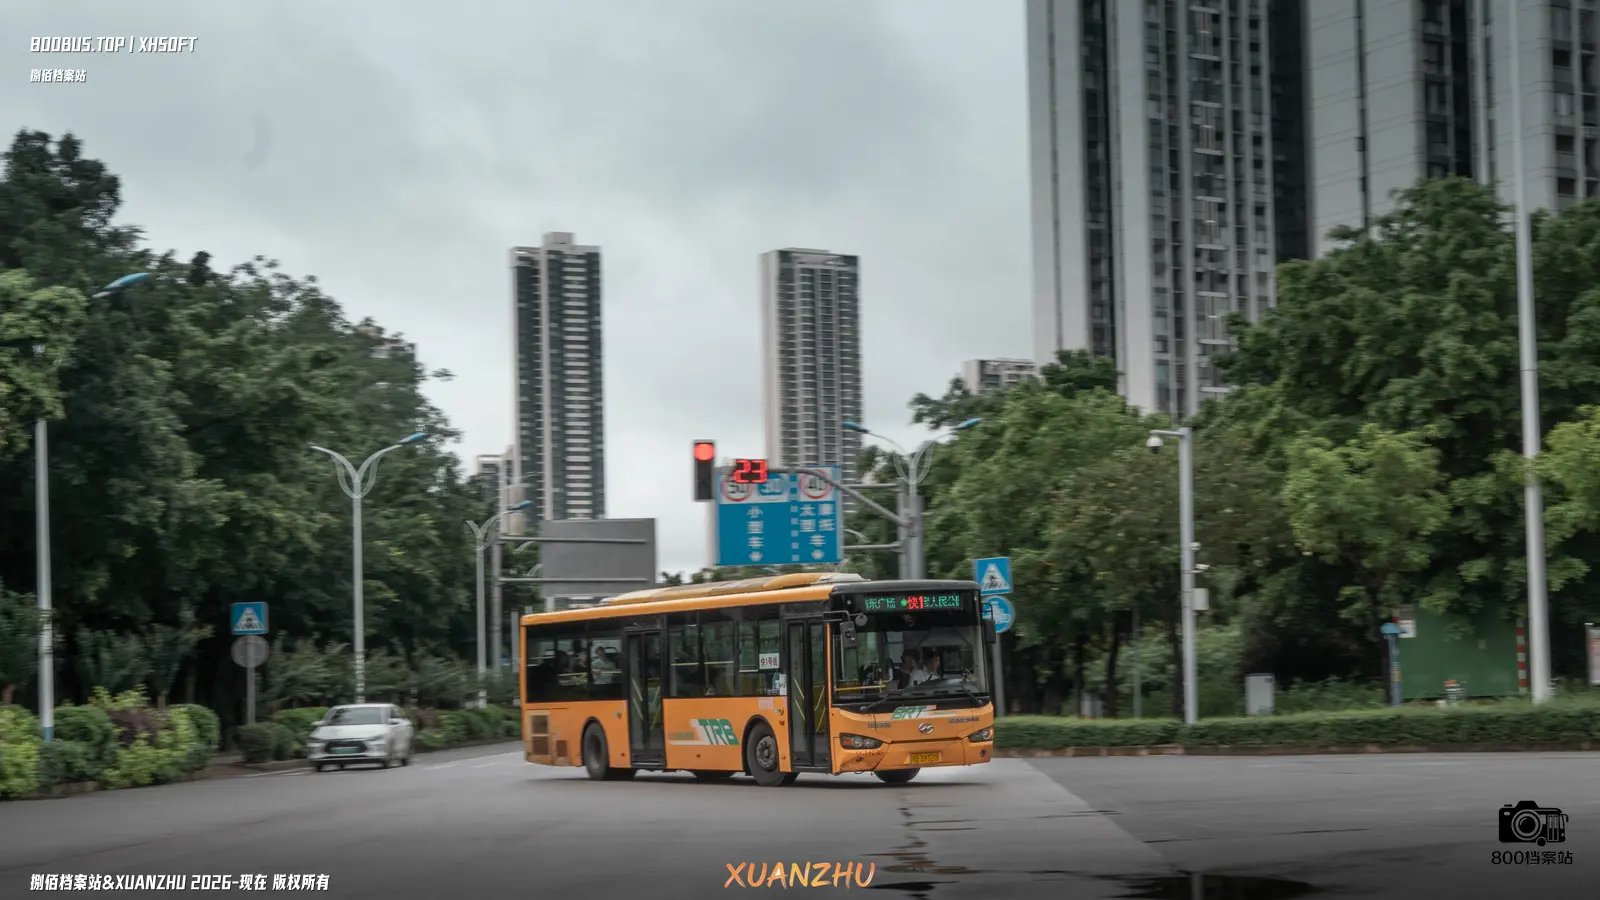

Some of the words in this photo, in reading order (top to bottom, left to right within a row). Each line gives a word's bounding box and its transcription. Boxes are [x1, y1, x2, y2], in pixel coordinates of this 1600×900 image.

[733, 459, 767, 483] 23
[865, 597, 896, 609] 东广场
